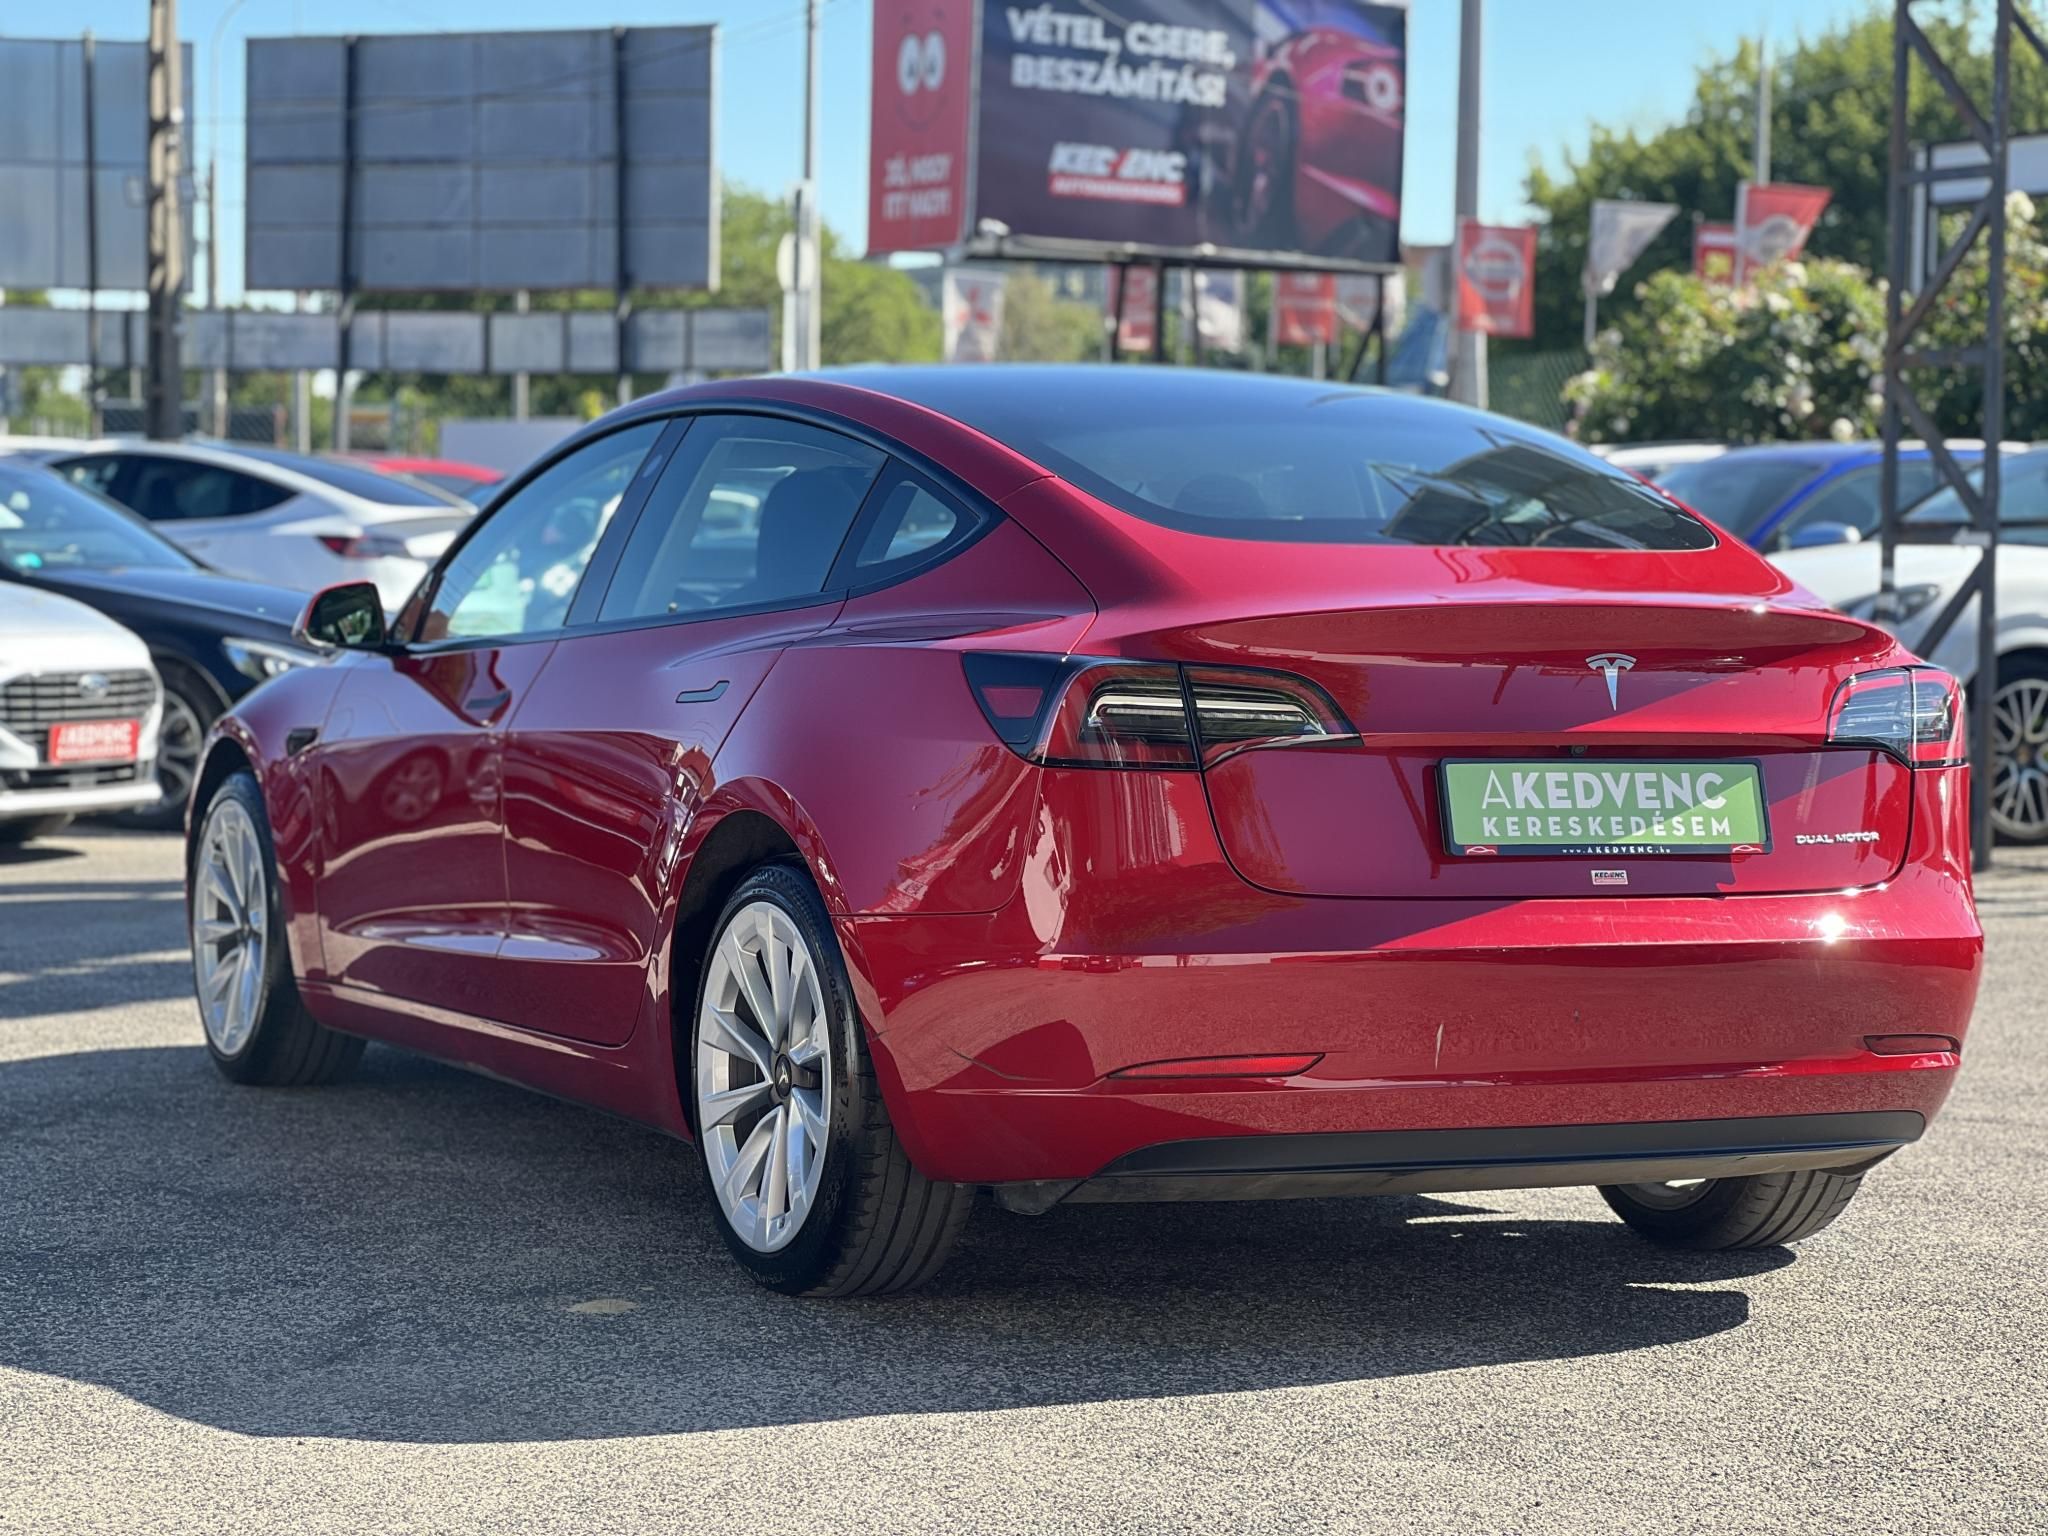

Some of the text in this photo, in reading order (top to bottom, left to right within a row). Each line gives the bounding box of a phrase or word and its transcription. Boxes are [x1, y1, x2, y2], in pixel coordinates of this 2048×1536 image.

[1006, 3, 1236, 69] VÉTEL, CSERE,
[1011, 52, 1227, 107] BESZÁMÍTÁS!
[1481, 769, 1728, 810] AKEDVENC
[1483, 811, 1731, 836] KERESKEDÉSEM
[1795, 831, 1880, 845] DUAL MOTOR
[1562, 844, 1671, 855] www.AKEDVENC.hu
